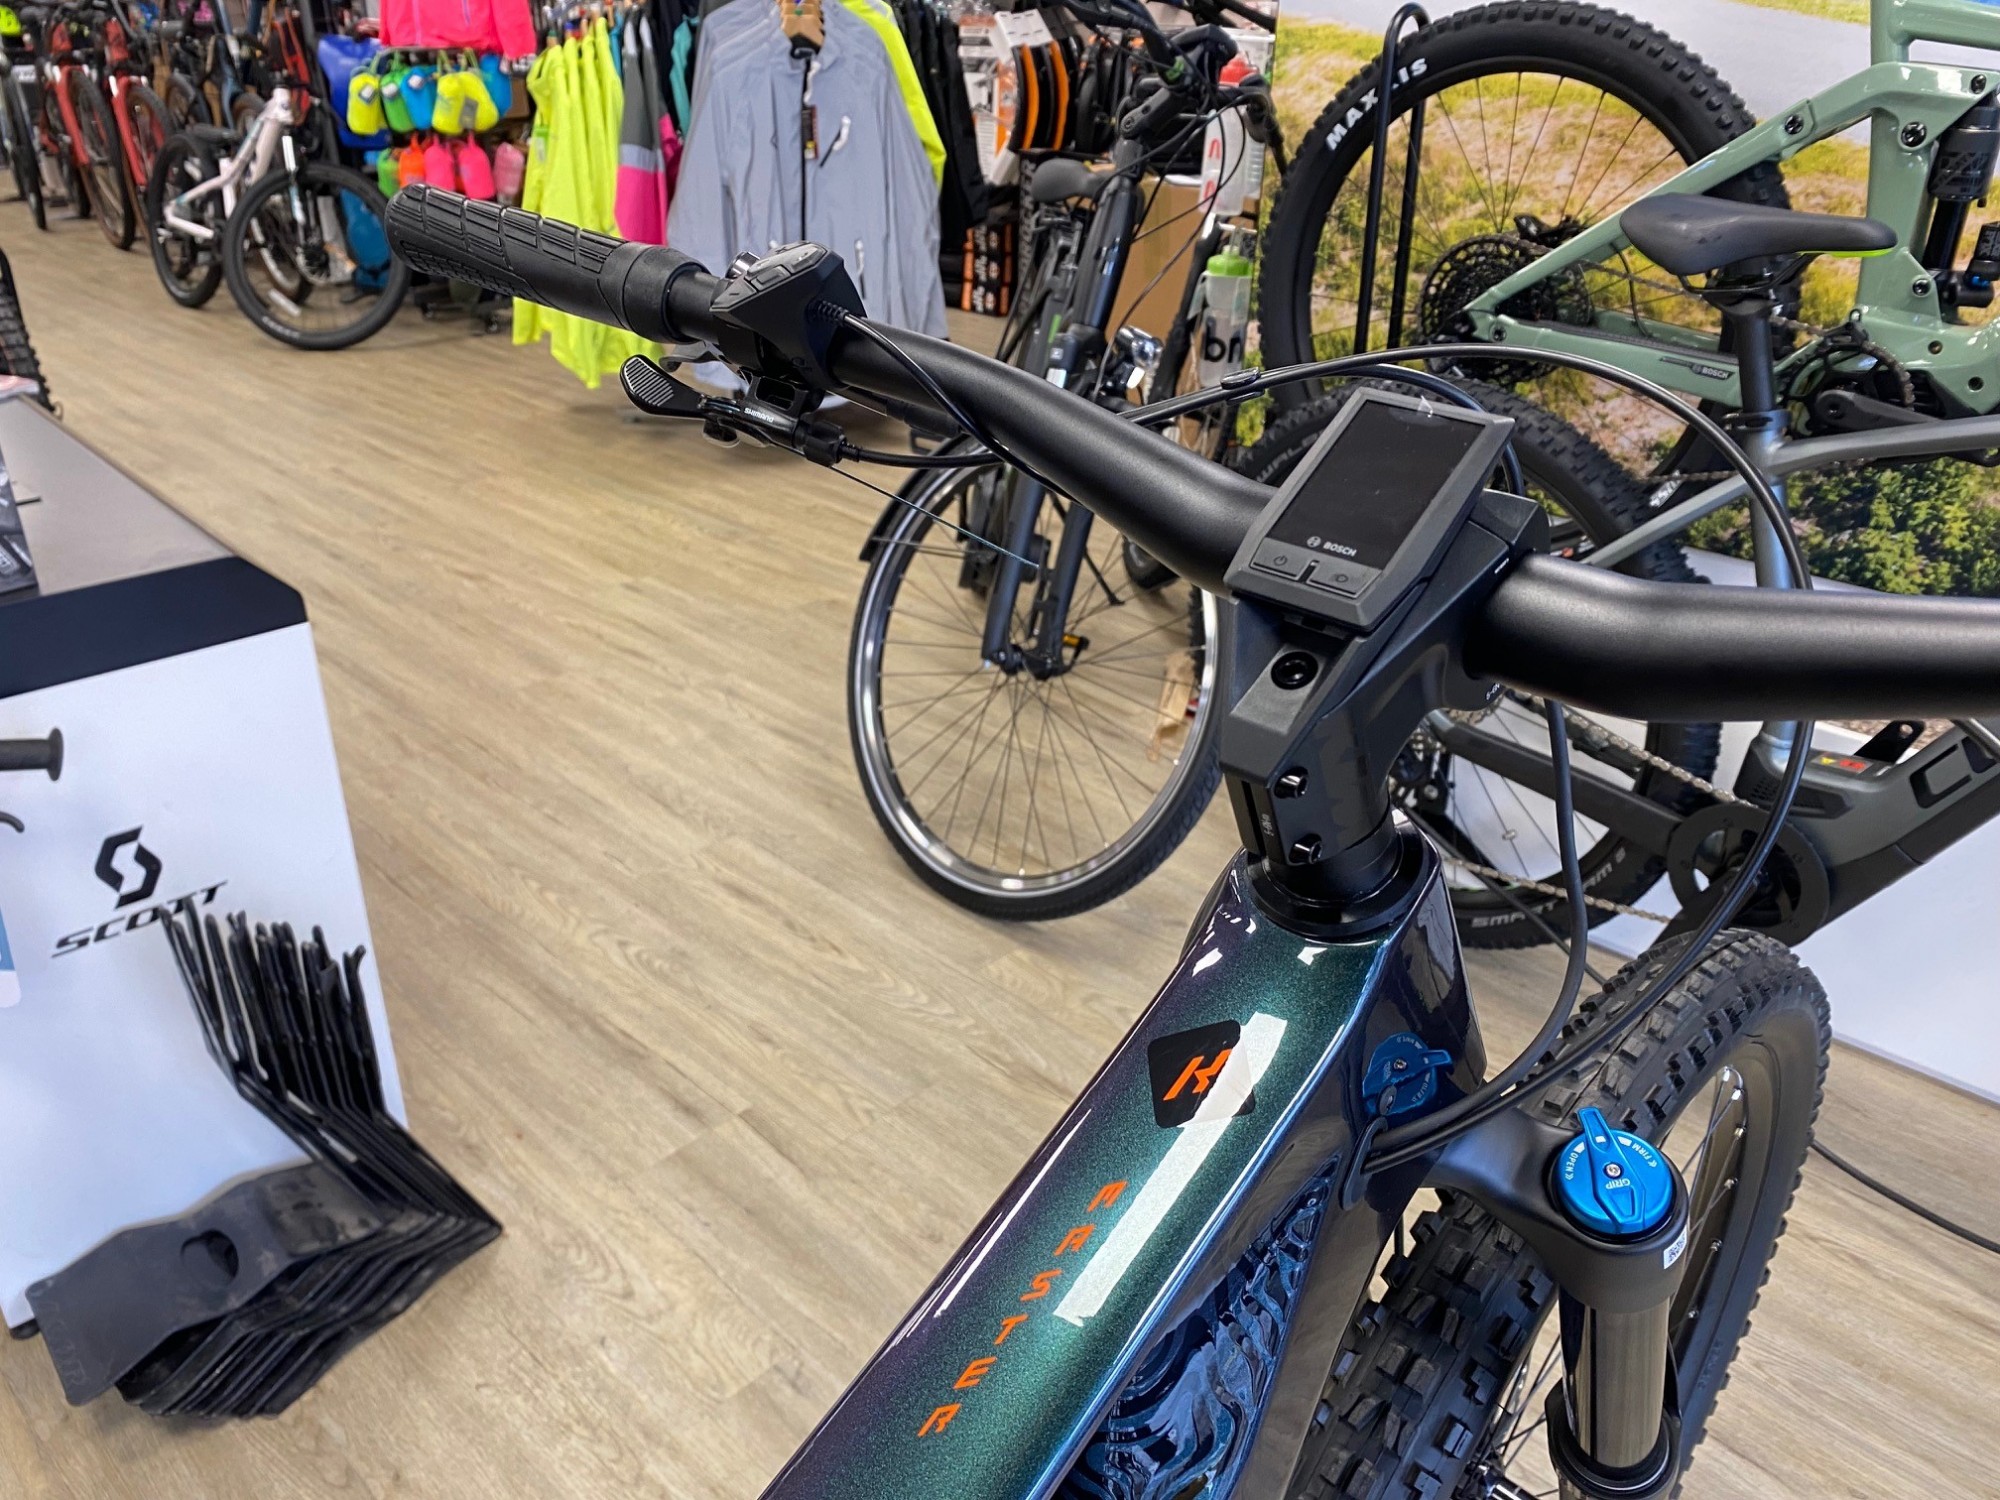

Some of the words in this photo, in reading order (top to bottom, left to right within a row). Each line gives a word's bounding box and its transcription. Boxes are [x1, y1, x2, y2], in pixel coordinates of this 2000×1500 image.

[1326, 58, 1427, 151] MAXIS
[1702, 366, 1729, 379] BOSCH
[1323, 541, 1357, 557] BOSCH
[51, 879, 228, 958] SCOTT
[1632, 1142, 1653, 1161] FIRM
[1566, 1152, 1578, 1173] OPEN
[1605, 1178, 1631, 1190] GRIP
[918, 1180, 1128, 1438] MASTER
